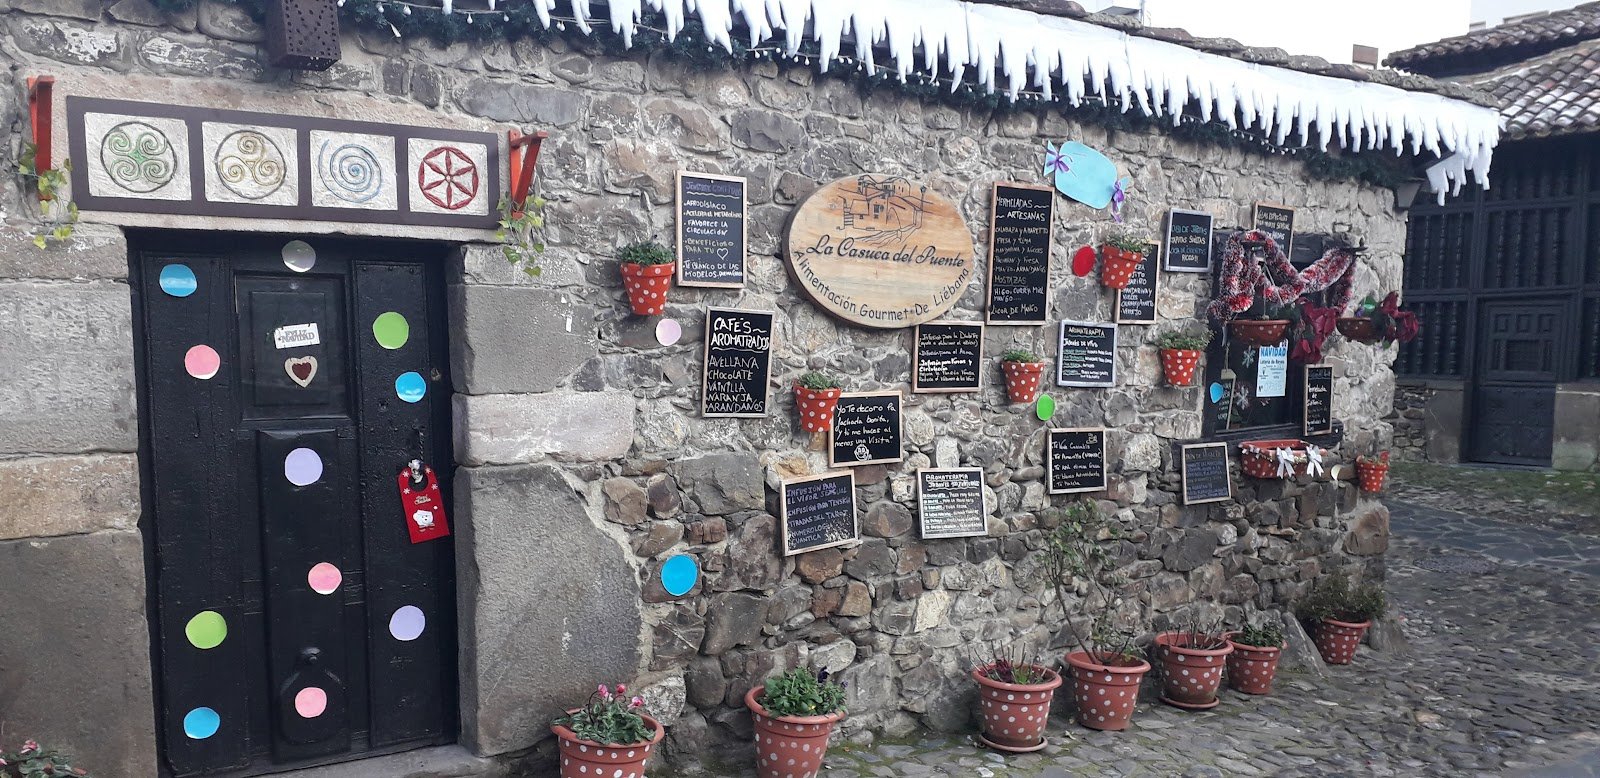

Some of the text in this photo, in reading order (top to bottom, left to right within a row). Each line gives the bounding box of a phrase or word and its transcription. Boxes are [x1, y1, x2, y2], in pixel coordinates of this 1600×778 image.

[1007, 211, 1046, 221] ARTESANAS
[688, 220, 728, 228] FAVORECE LA
[685, 246, 702, 254] PARA
[806, 234, 965, 267] La Casuca del Puente
[692, 262, 715, 270] BLANCO
[794, 251, 969, 320] Alimentación Gourmet De Liébana
[994, 276, 1027, 285] MOSTAZAS
[1010, 306, 1018, 314] DE
[280, 332, 315, 343] NAVIDAD
[1261, 347, 1286, 357] NAVIDAD
[709, 355, 759, 369] AVELLANA
[708, 369, 754, 380] CHOCOLATE
[708, 381, 746, 392] VAINILLA
[708, 392, 753, 402] NARANJA
[856, 405, 883, 413] decoro
[863, 426, 881, 434] haces
[822, 482, 837, 490] PARA
[797, 493, 818, 502] VIGOR
[820, 487, 847, 498] SEXUAL
[789, 516, 813, 527] TIRADAS
